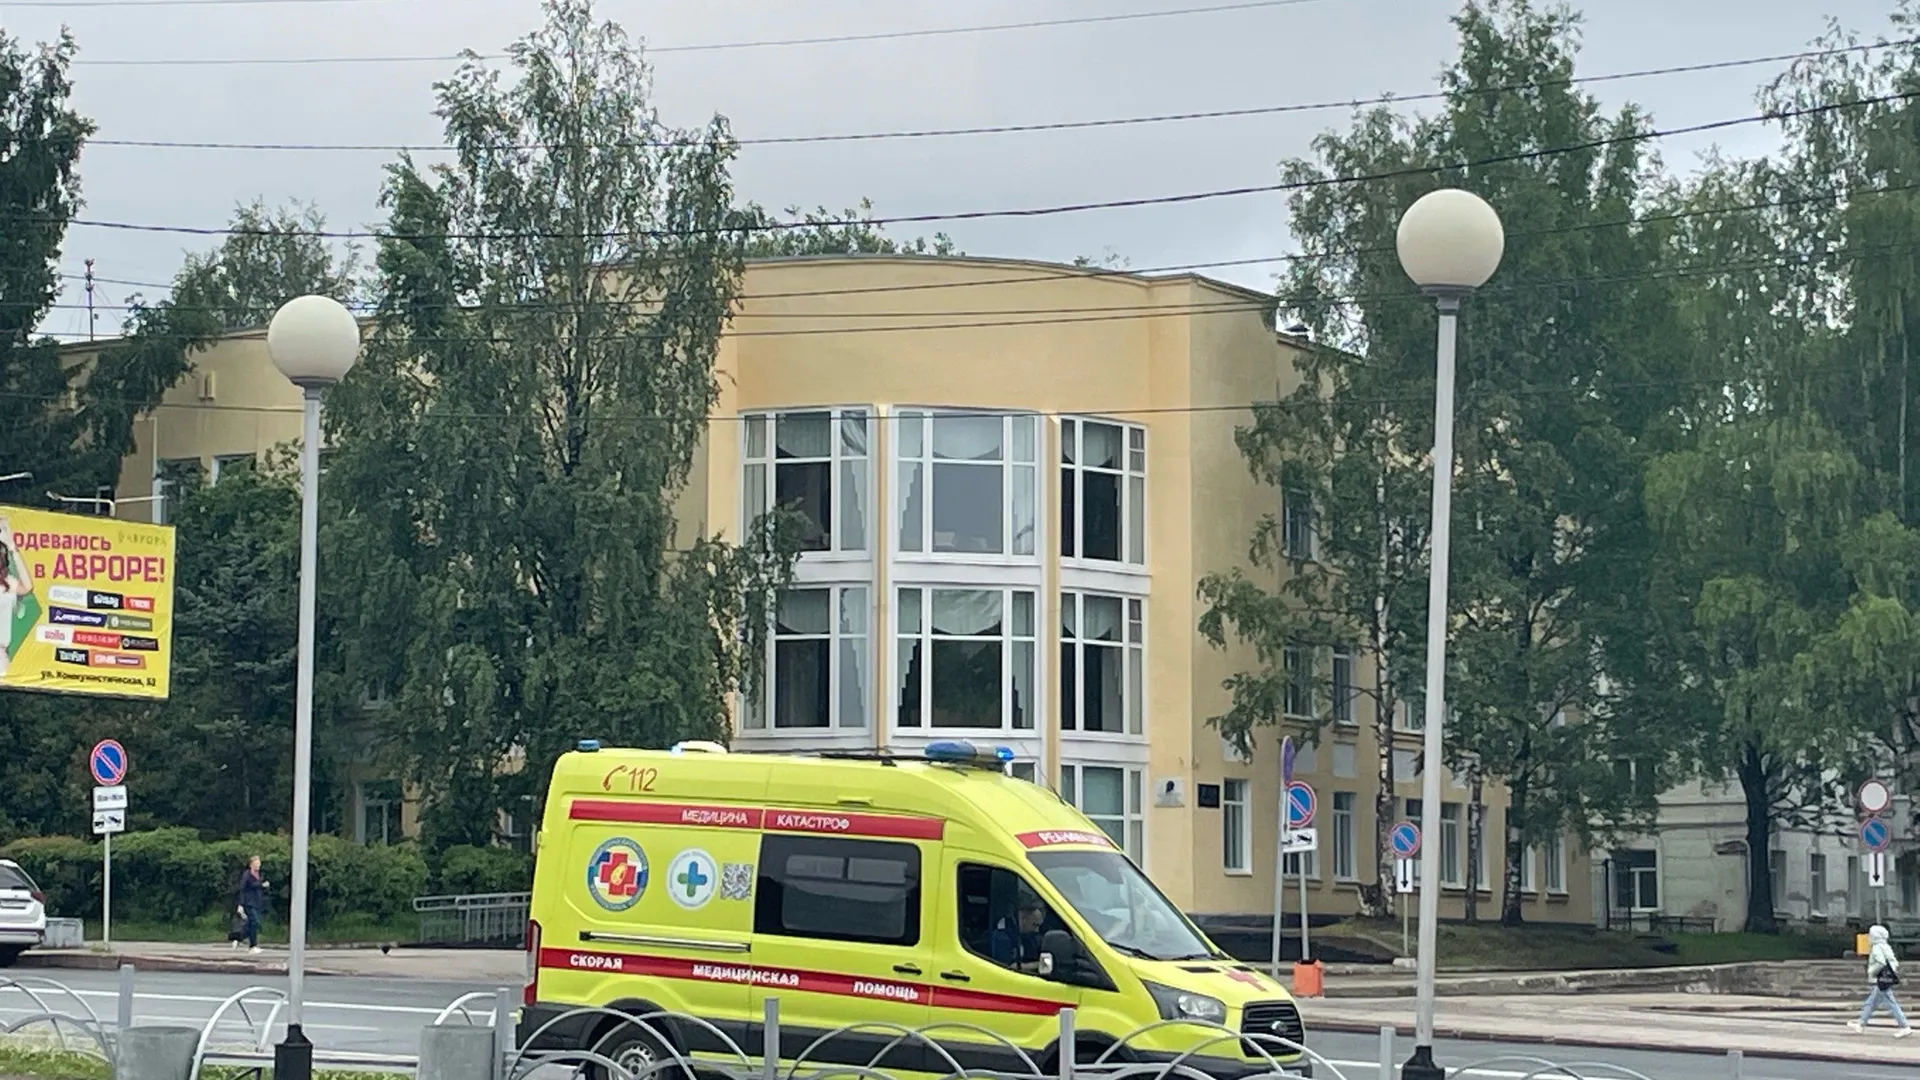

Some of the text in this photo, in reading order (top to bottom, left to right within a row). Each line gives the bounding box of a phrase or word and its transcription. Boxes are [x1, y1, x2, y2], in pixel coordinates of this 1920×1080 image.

[13, 532, 112, 551] одеваюсь
[34, 553, 165, 583] в АВРОРЕ!
[628, 767, 657, 792] 112
[681, 809, 850, 830] МЕДИЦИНА КАТАСТРОФ
[570, 953, 919, 1001] СКОРАЯ МЕДИЦИНСКАЯ ПОМОЩЬ
